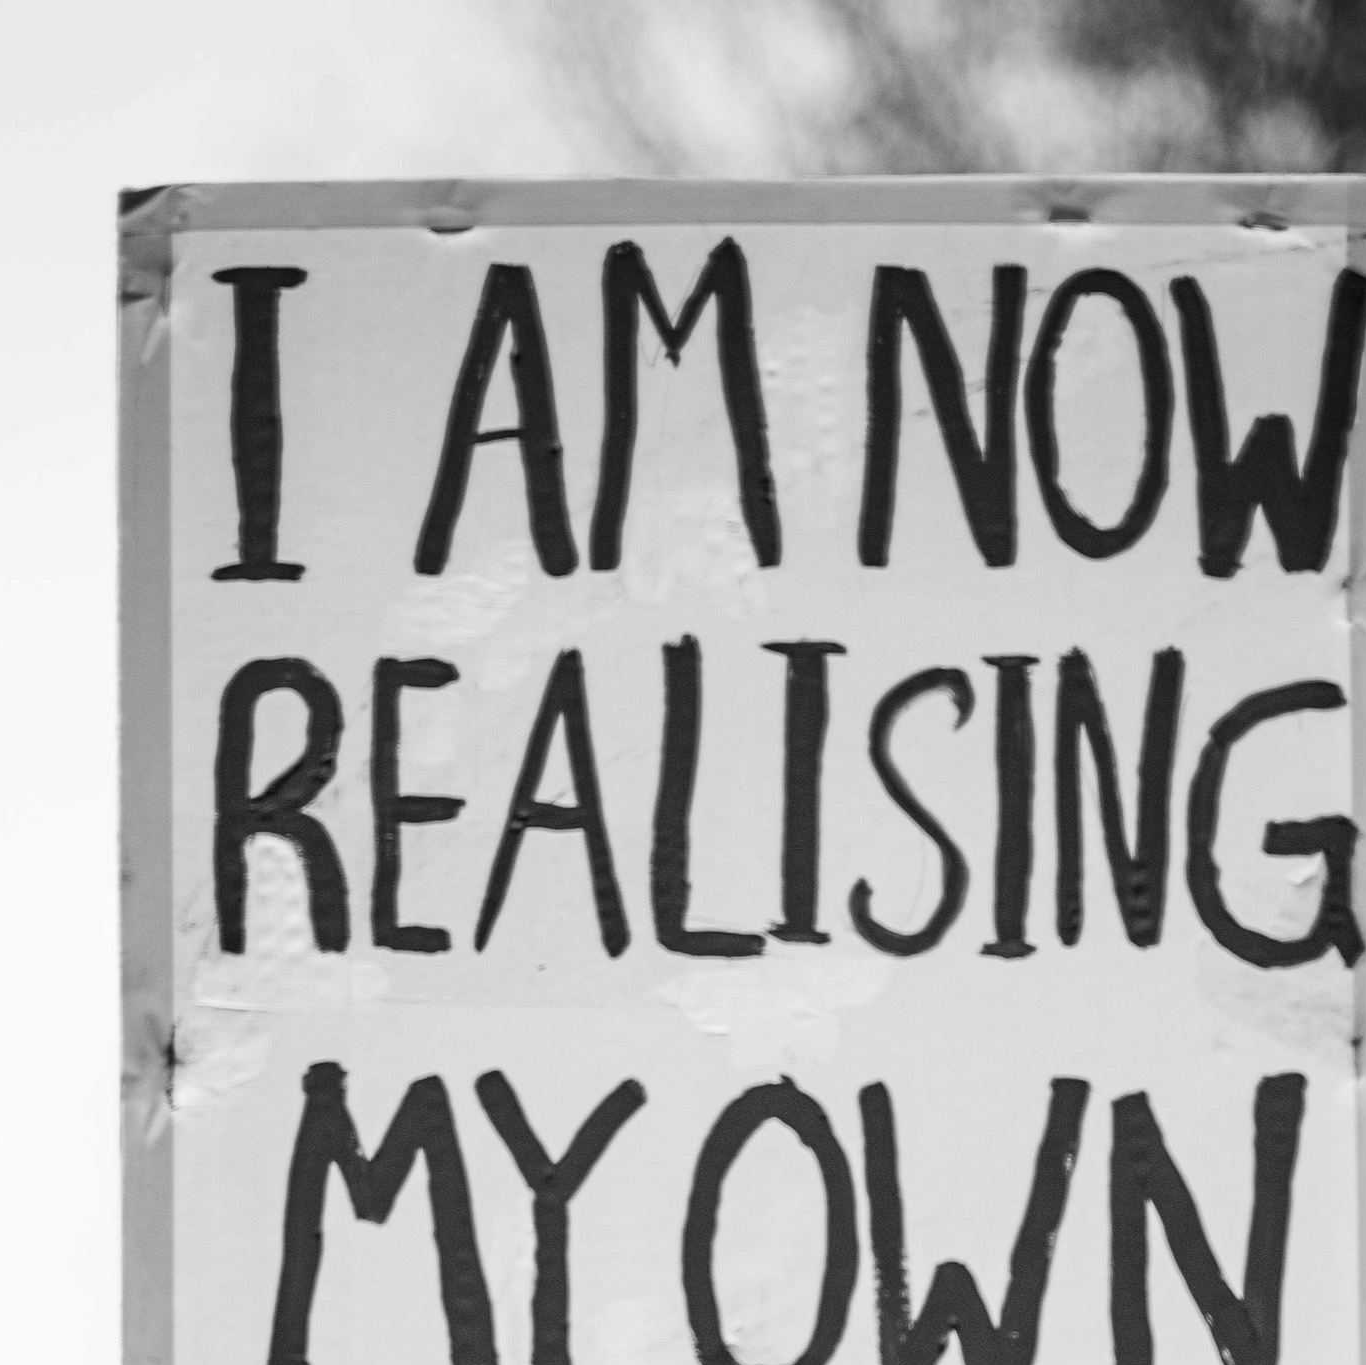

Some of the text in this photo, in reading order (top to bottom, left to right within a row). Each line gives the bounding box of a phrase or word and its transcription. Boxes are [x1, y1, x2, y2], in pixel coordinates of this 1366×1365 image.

[211, 266, 307, 581] I
[414, 237, 781, 577] AM
[214, 635, 1366, 968] REALISING
